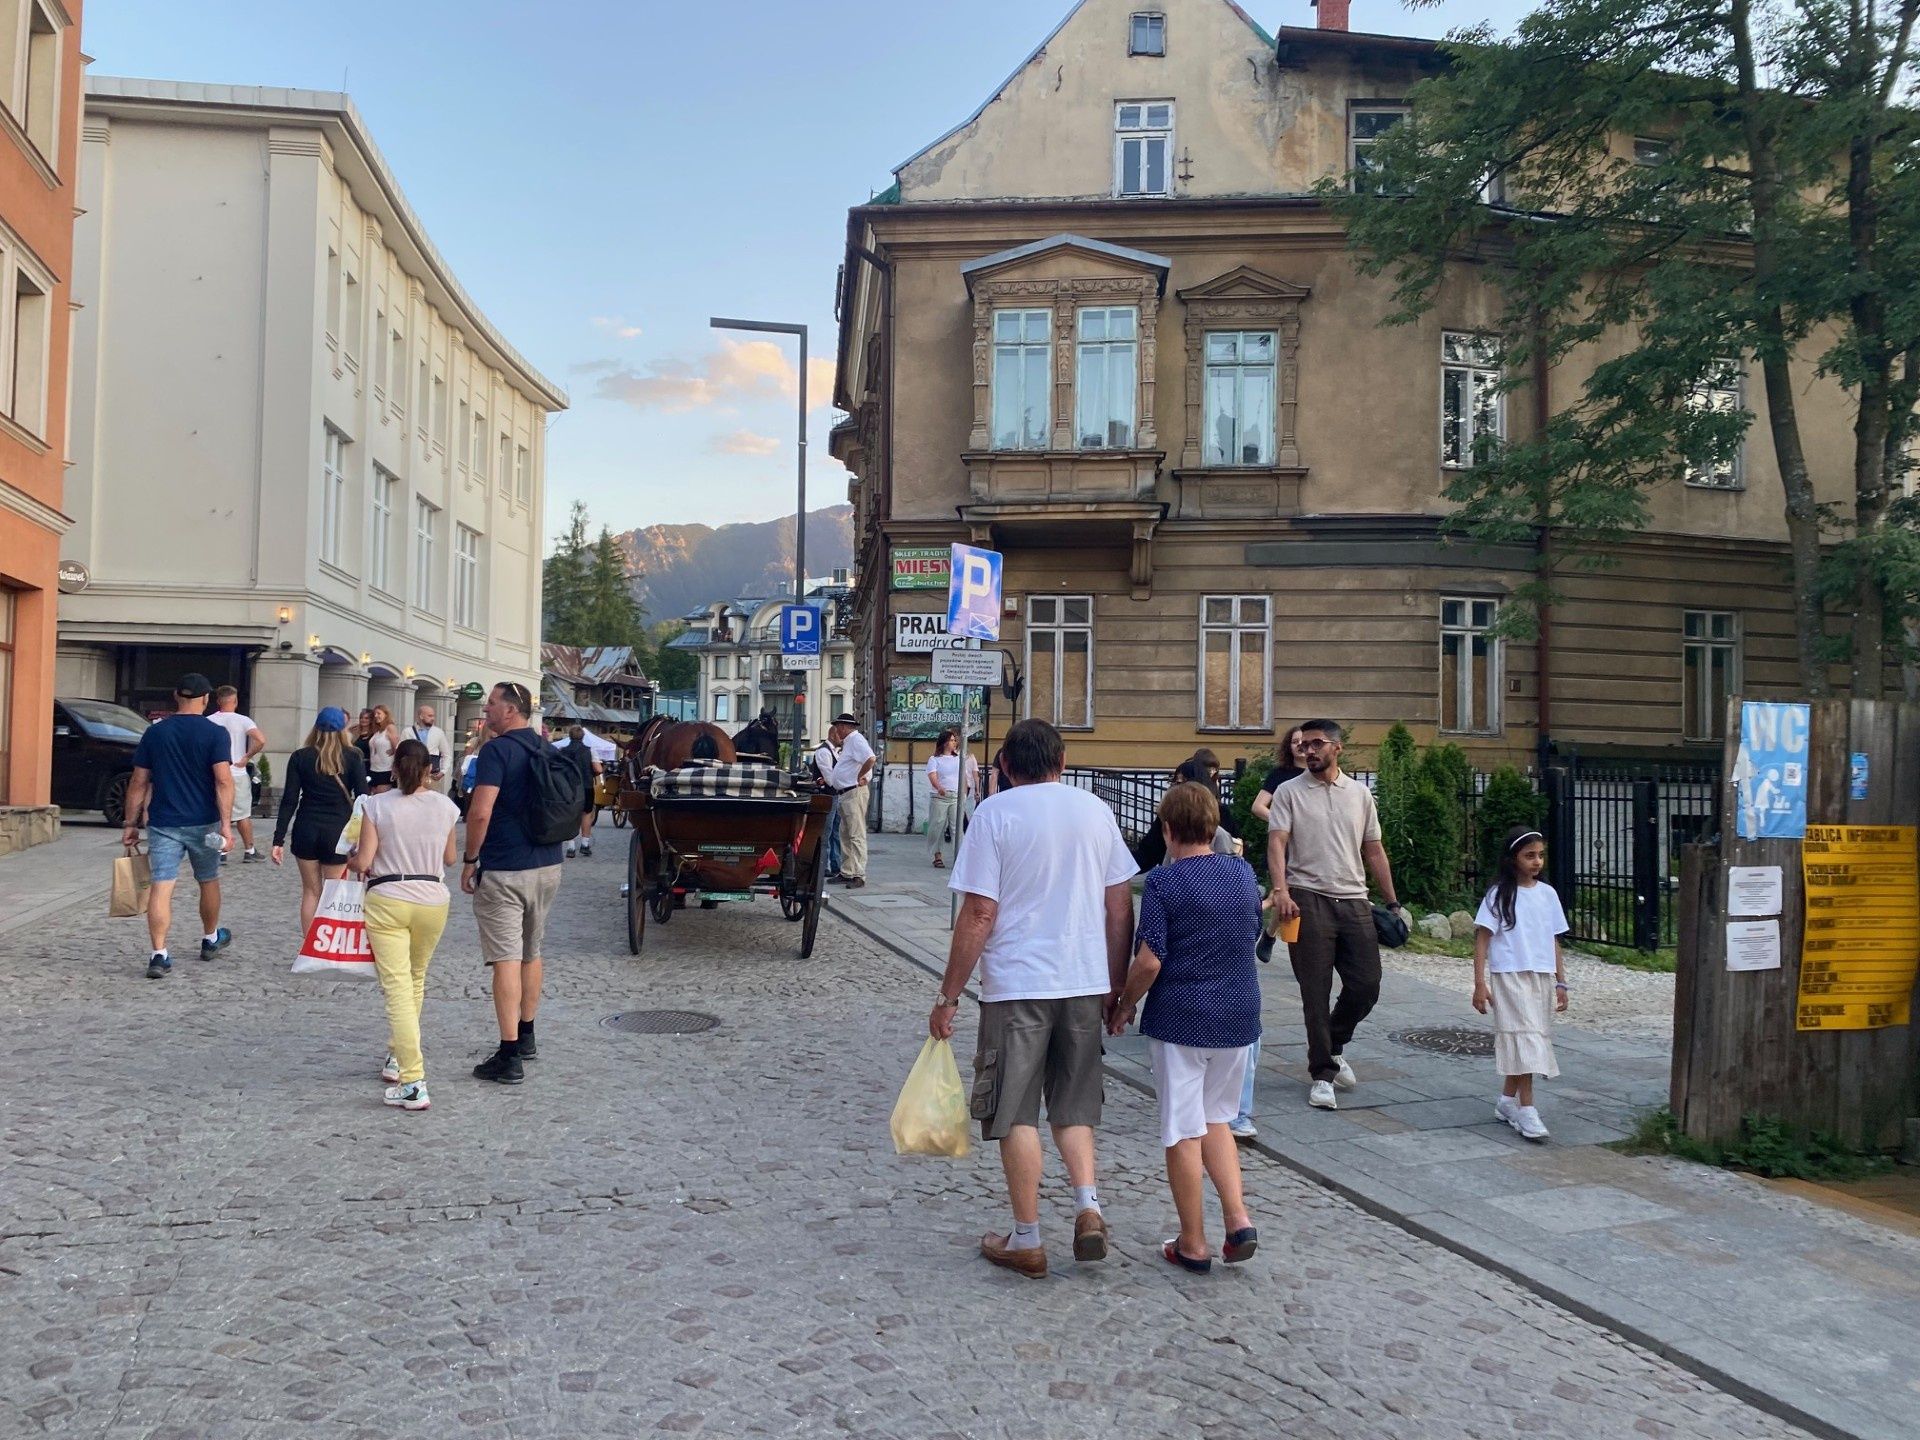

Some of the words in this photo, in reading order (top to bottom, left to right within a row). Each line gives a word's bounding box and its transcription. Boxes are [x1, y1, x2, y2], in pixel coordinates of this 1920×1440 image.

[57, 569, 86, 582] Wawel
[961, 554, 992, 609] P
[790, 609, 813, 640] P
[900, 636, 950, 648] Laundry
[1748, 705, 1806, 753] WC
[313, 924, 371, 955] SALE
